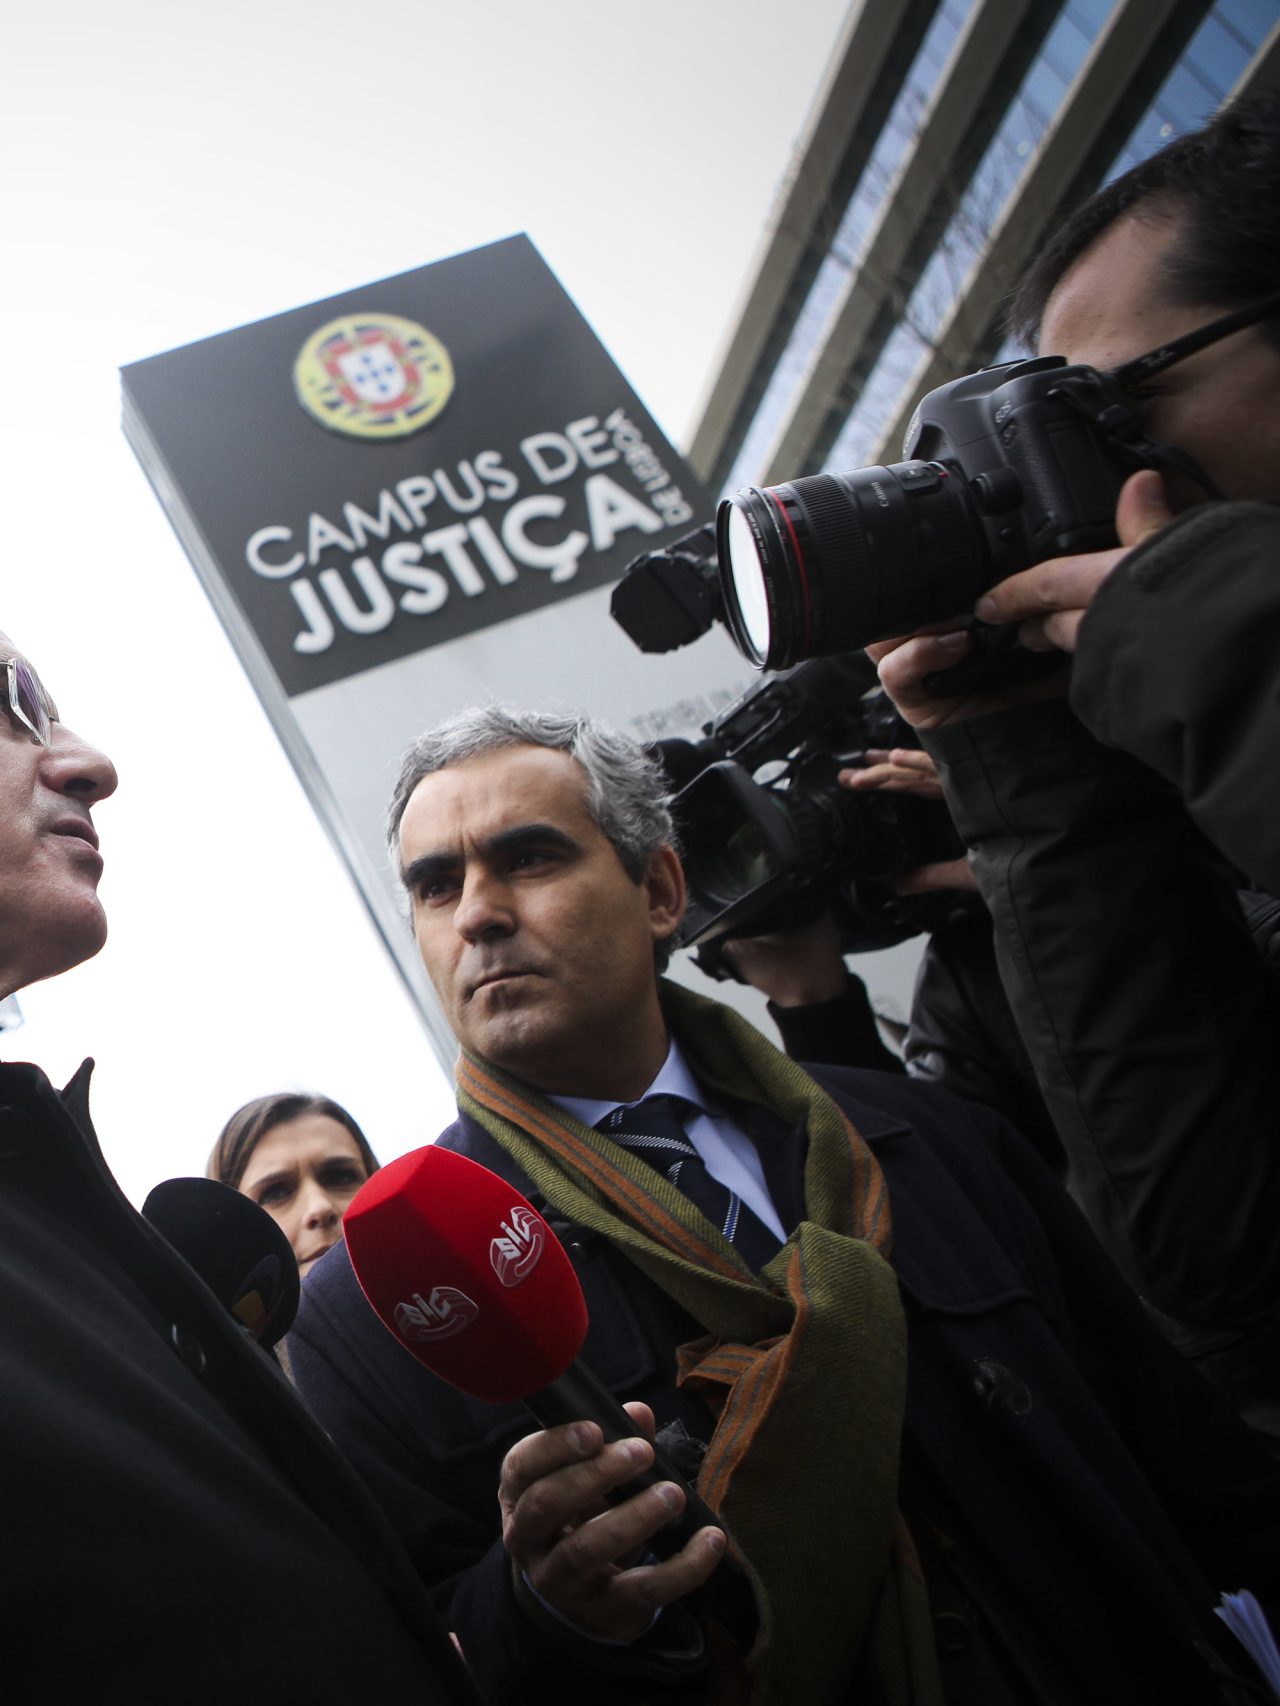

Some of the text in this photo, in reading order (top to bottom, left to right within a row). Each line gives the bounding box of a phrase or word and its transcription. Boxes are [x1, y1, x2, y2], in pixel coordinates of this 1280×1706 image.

[245, 415, 619, 579] CAMPUS DE
[605, 407, 694, 527] DE LISBOA
[289, 473, 665, 653] JUSTIÇA
